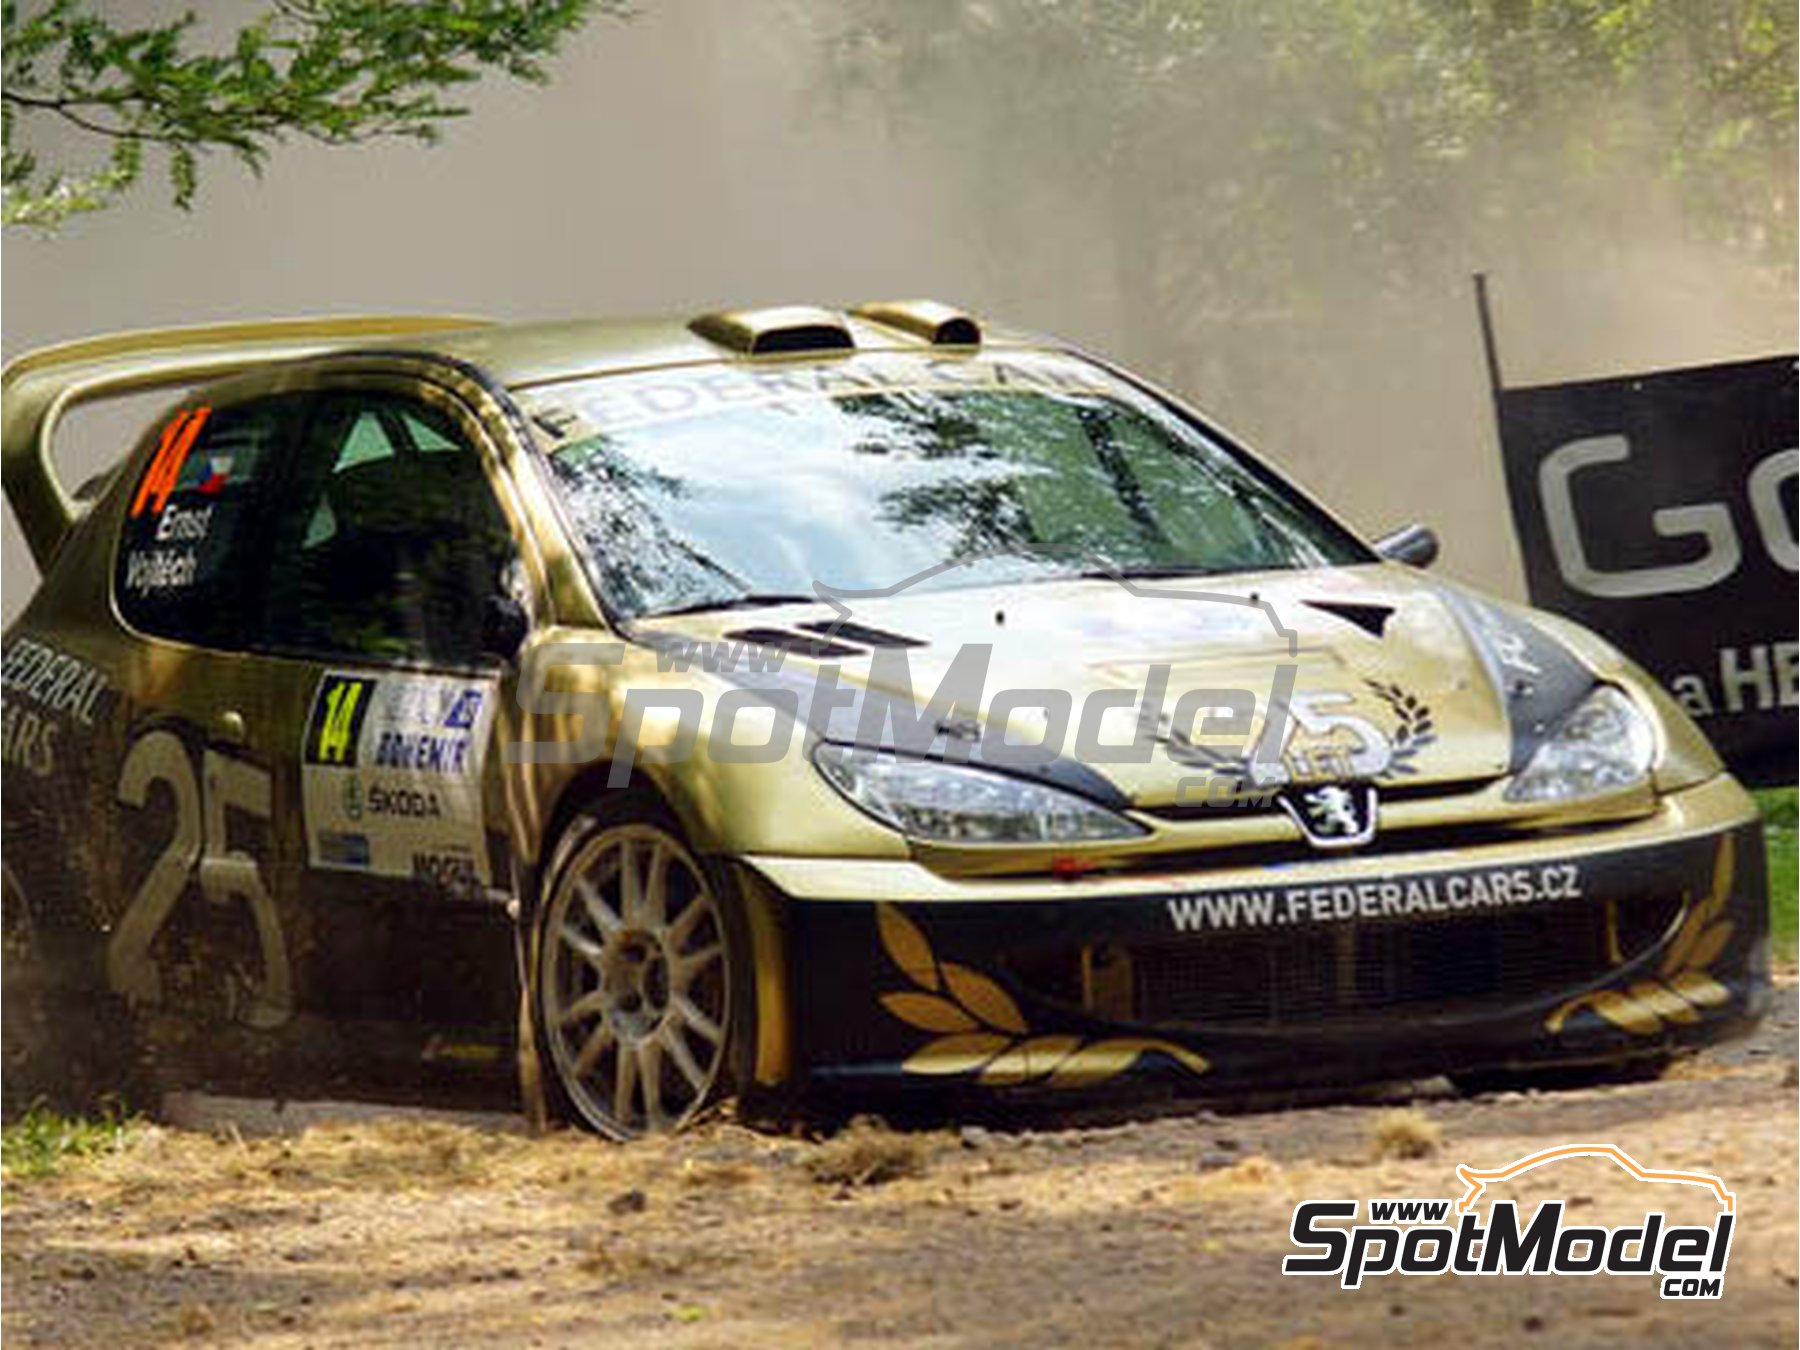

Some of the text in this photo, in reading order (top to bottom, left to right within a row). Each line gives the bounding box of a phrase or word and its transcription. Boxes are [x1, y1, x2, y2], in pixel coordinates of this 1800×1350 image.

[128, 407, 213, 519] 14
[1, 697, 59, 777] ARS
[318, 681, 363, 763] 14
[366, 780, 442, 817] ŠKODA
[108, 730, 293, 1028] 25
[1168, 866, 1582, 932] WWW.FEDERALCARS.CZ
